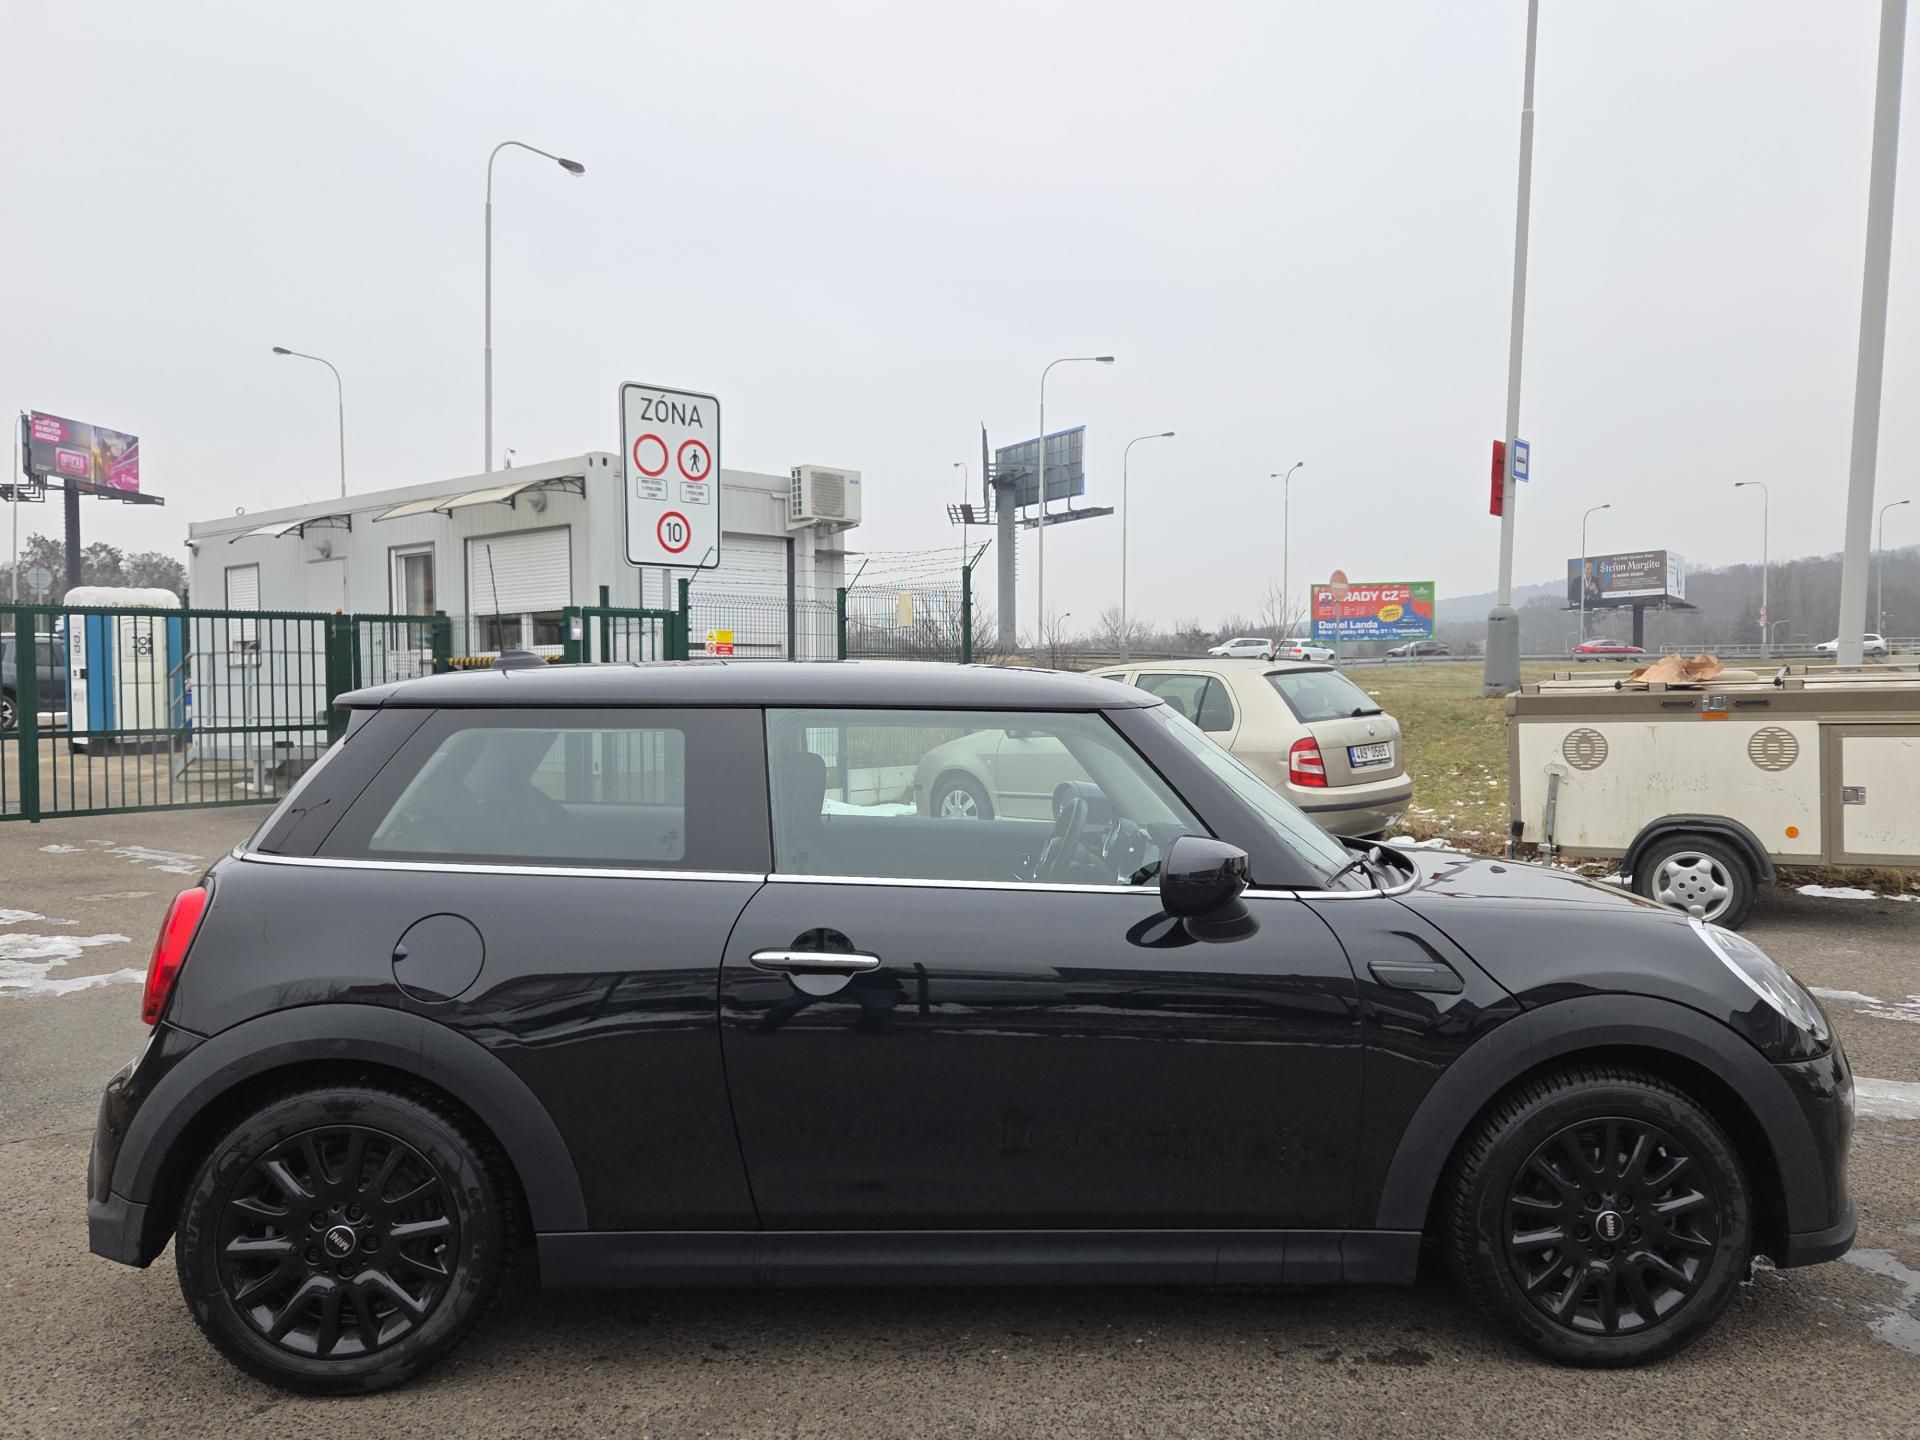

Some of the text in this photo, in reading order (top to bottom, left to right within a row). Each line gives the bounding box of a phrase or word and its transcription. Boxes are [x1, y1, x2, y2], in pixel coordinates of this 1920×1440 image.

[640, 395, 703, 428] ZÓNA
[666, 523, 682, 542] 10
[1627, 560, 1660, 571] Margita
[1381, 590, 1399, 601] CZ
[1318, 620, 1378, 629] Danel Landa
[1605, 1215, 1615, 1236] MINI
[329, 1231, 350, 1251] MINI
